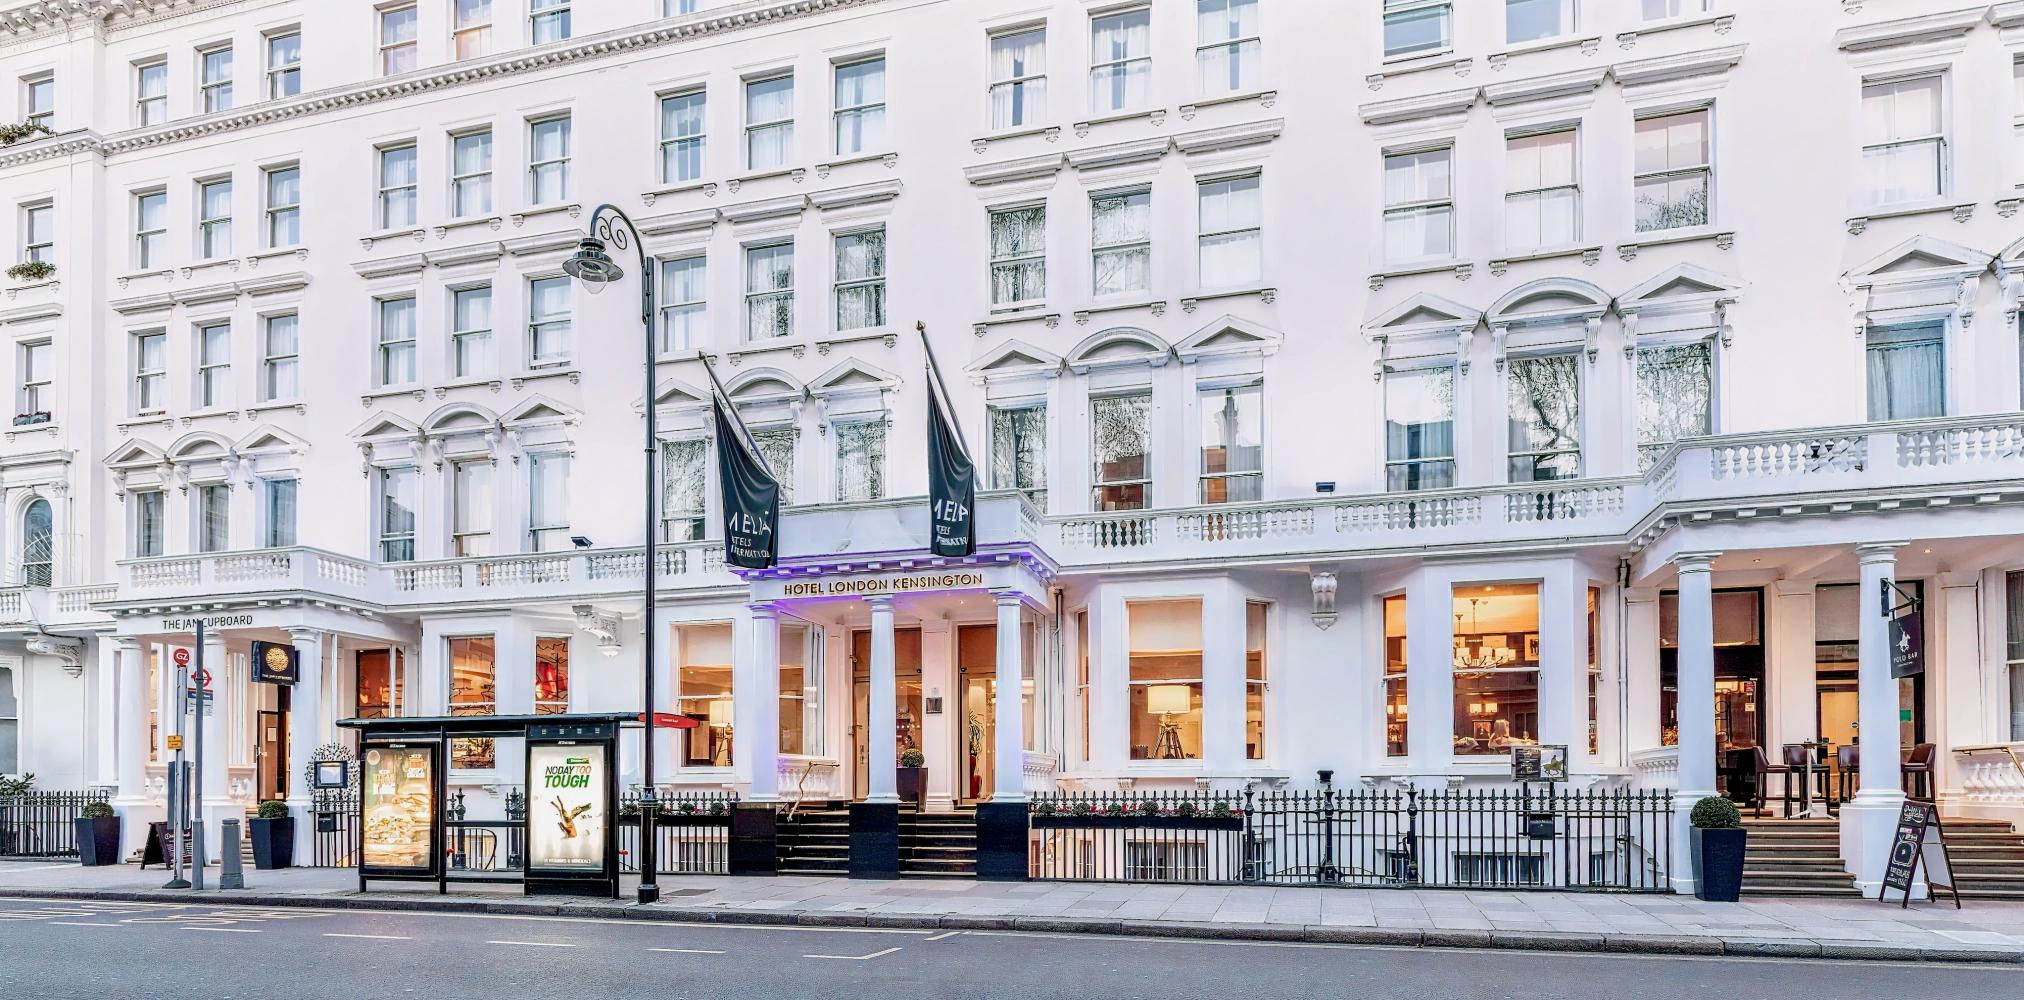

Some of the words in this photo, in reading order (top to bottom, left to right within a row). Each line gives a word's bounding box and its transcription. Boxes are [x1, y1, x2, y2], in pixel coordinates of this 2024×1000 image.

[731, 535, 752, 547] TELS
[784, 583, 824, 595] HOTEL
[829, 579, 888, 593] LONDON
[893, 573, 983, 589] KENSINGTON
[163, 619, 181, 630] THE
[176, 652, 189, 661] GZ
[575, 765, 592, 775] TOO
[544, 774, 591, 788] TOUGH
